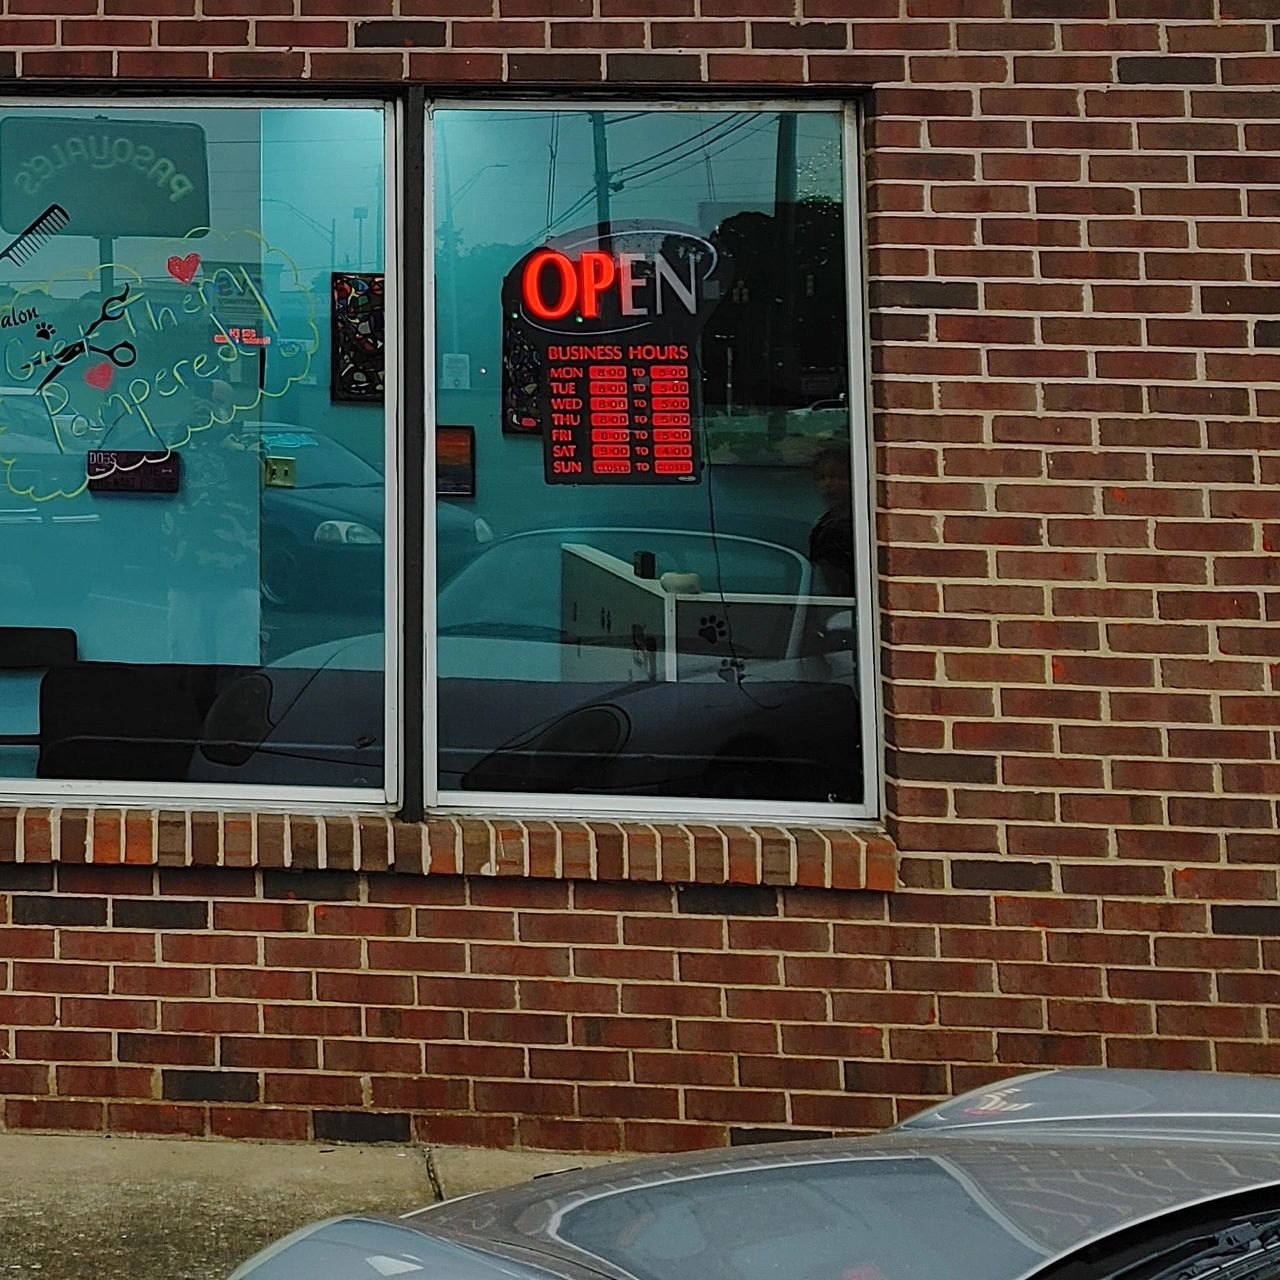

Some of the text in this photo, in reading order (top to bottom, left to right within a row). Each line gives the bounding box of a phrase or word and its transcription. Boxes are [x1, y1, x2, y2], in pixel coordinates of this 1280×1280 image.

[523, 251, 698, 319] OPEN
[548, 345, 688, 360] BUSINESS HOURS
[550, 368, 583, 378] MON
[632, 368, 645, 377] TO
[41, 313, 257, 454] Pampered
[551, 383, 576, 393] TUE
[633, 384, 646, 392] TO
[551, 399, 583, 409] WED
[634, 400, 647, 408] TO
[552, 414, 580, 425] THU
[634, 415, 647, 423] TO
[552, 430, 571, 441] FRI
[635, 431, 648, 439] TO
[553, 445, 576, 457] SAT
[635, 446, 649, 455] TO
[553, 461, 582, 473] SUN
[636, 462, 649, 471] TO
[658, 463, 690, 471] CLOSED
